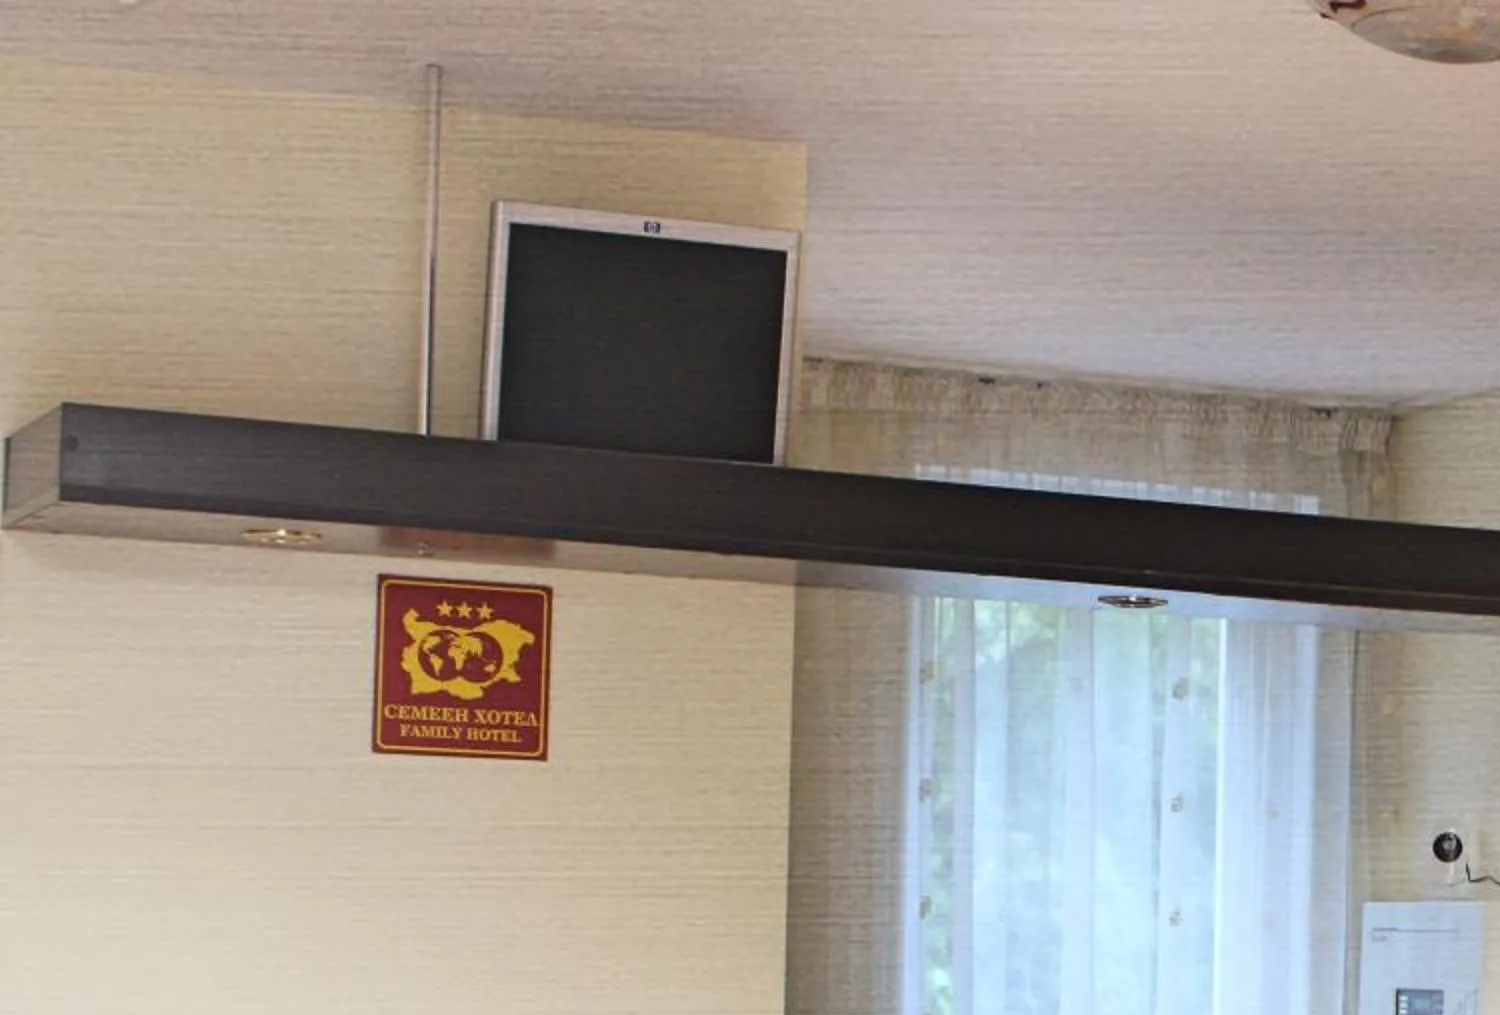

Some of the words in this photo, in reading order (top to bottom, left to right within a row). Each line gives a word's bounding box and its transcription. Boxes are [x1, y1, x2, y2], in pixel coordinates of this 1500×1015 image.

[384, 704, 469, 723] СЕМЕЕН
[473, 708, 539, 727] ХОТЕЛ
[400, 723, 463, 740] FAMILY
[467, 728, 522, 743] HOTEL
